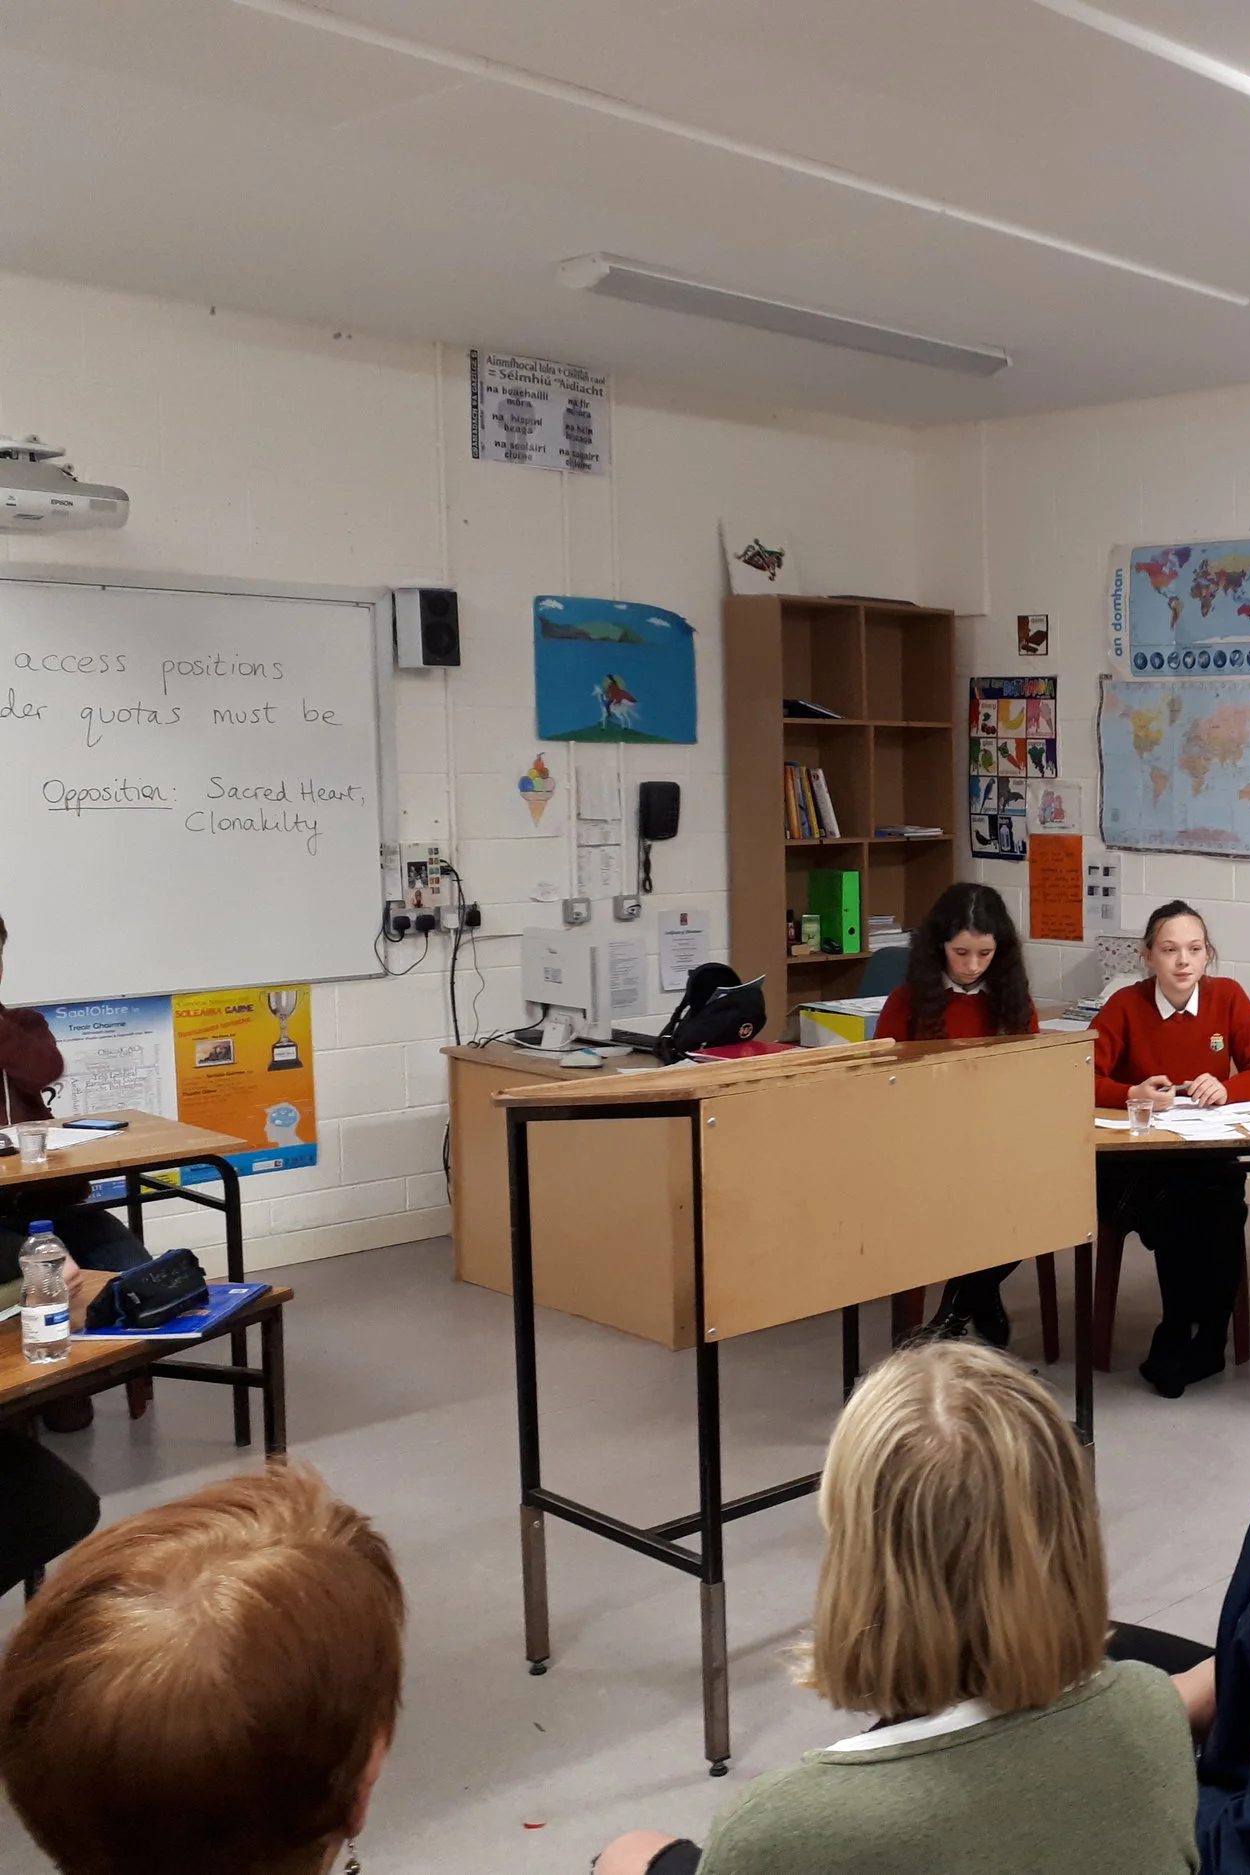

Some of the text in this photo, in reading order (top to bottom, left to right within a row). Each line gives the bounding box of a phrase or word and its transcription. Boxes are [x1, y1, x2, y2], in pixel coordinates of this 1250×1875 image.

[487, 385, 499, 393] na
[492, 413, 504, 421] na
[495, 440, 506, 448] na
[1111, 568, 1123, 657] an domhan
[15, 652, 285, 695] access positions
[80, 700, 182, 748] quotas
[213, 702, 278, 725] must
[302, 698, 343, 726] be
[206, 776, 290, 802] Sacred
[184, 810, 322, 857] Clonakilty
[55, 1004, 129, 1020] SaolOibre
